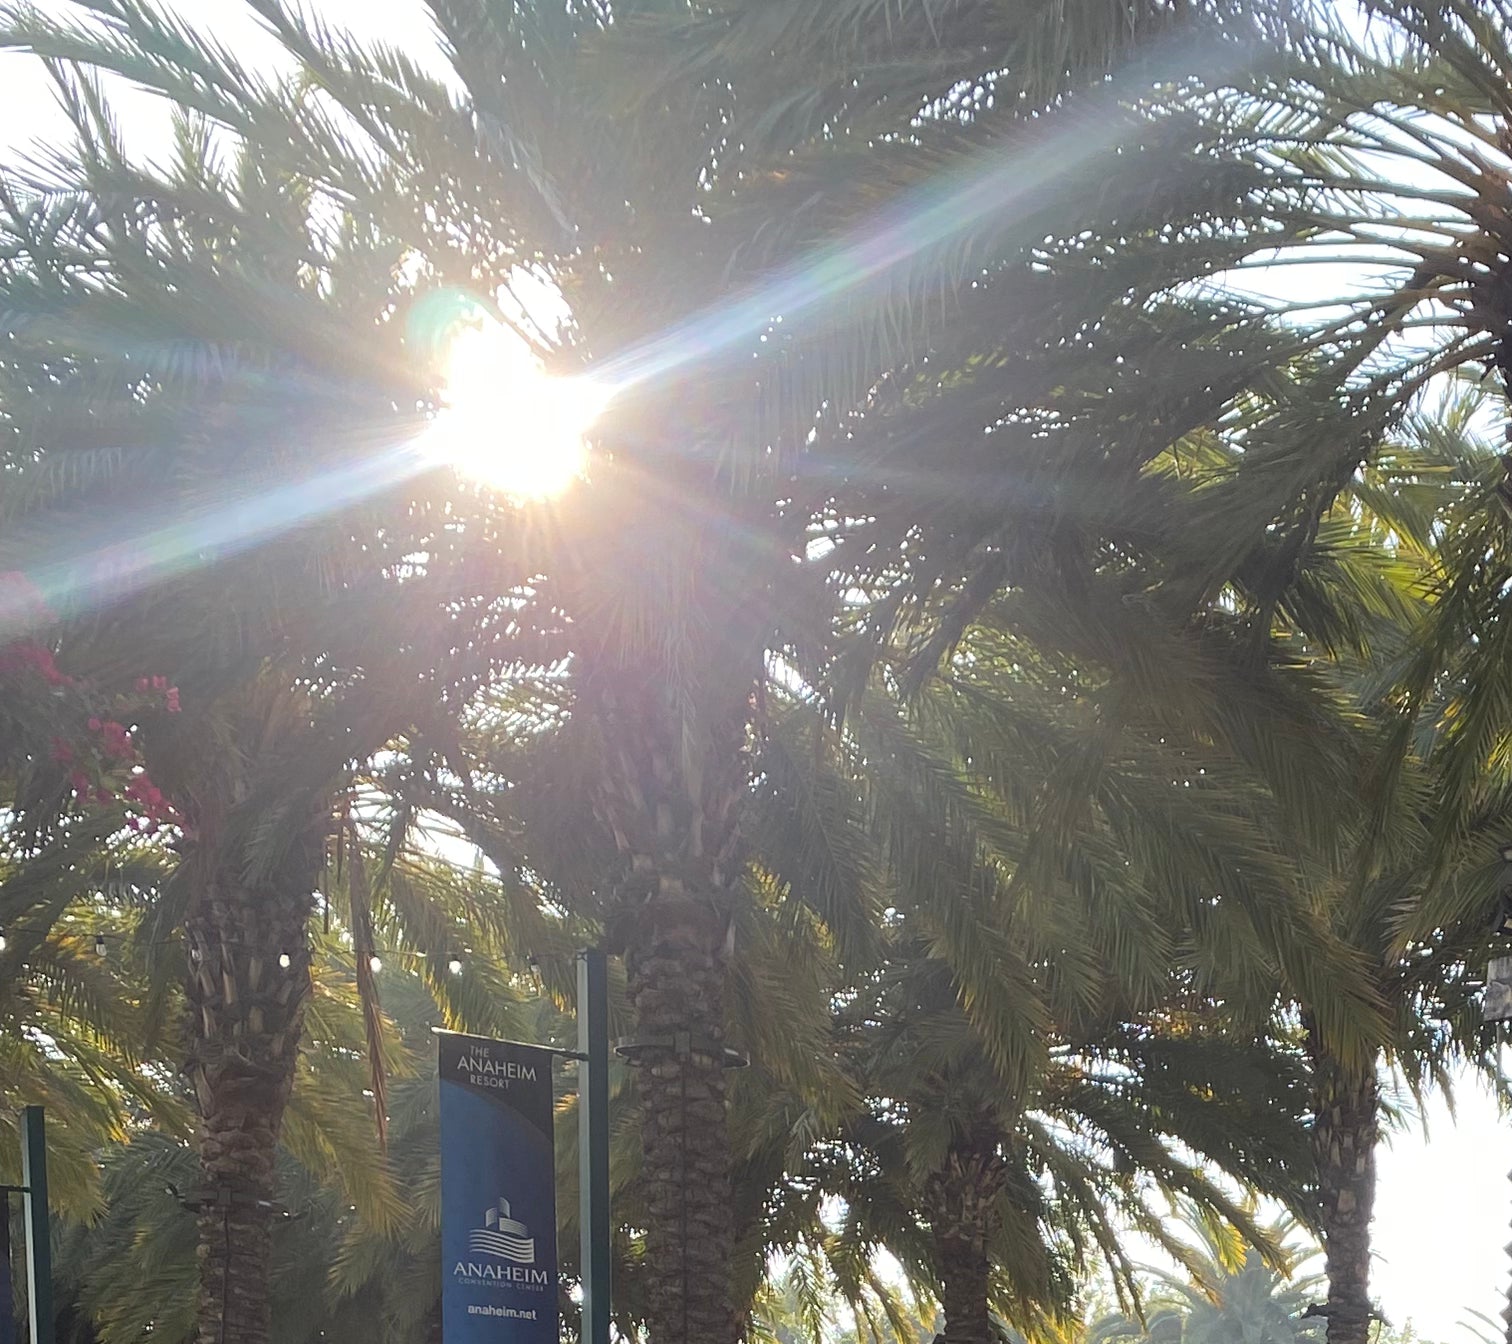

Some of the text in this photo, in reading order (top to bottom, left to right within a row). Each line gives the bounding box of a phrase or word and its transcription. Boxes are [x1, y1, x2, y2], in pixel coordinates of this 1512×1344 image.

[470, 1046, 489, 1058] THE
[457, 1056, 537, 1081] ANAHEIM
[470, 1075, 511, 1088] RESORT
[454, 1262, 548, 1285] ANAHEIM
[458, 1277, 512, 1288] CONVENTION
[468, 1305, 537, 1320] anaheim.net
